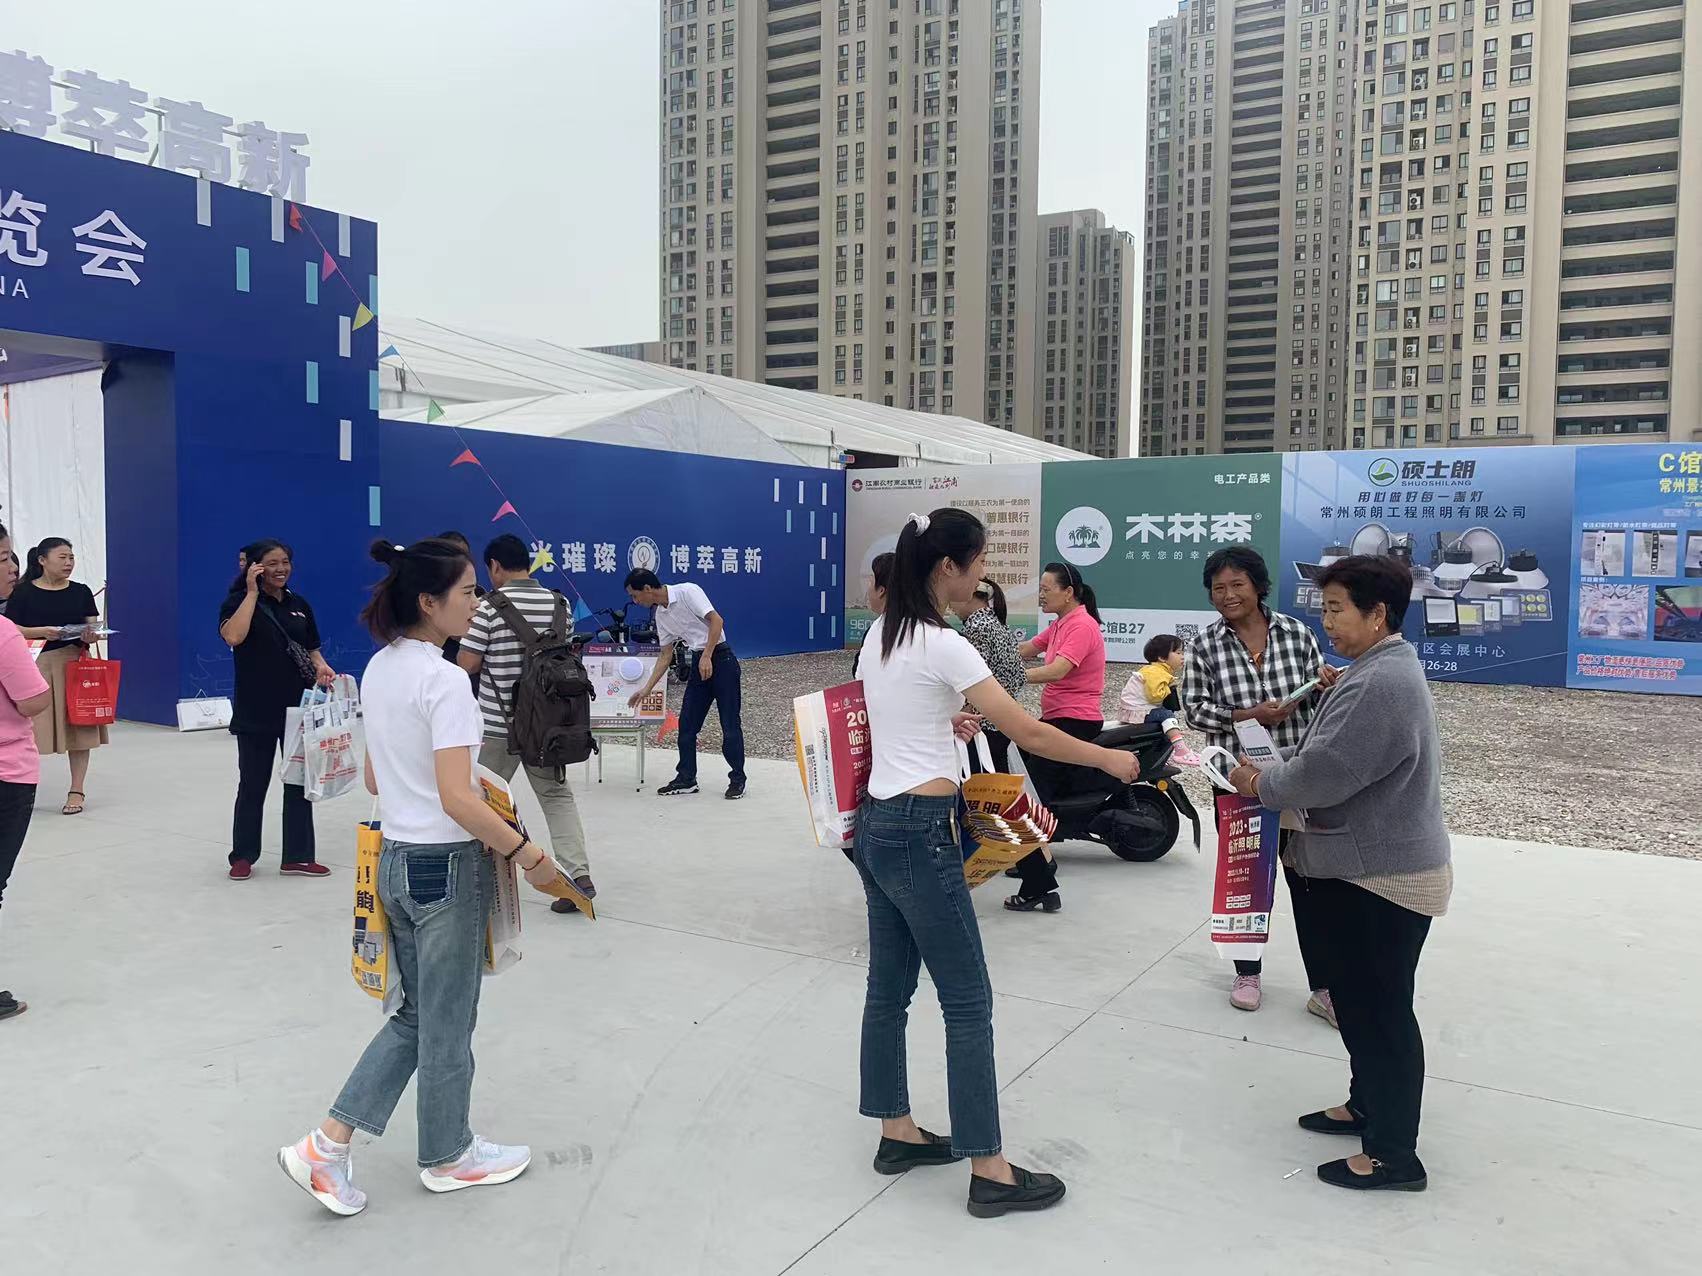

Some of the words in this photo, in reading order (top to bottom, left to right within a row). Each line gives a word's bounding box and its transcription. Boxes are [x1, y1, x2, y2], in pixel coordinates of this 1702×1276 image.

[1401, 460, 1476, 480] 硕士朗
[1214, 472, 1272, 485] 电工产品类
[1659, 477, 1702, 493] 常州景
[1358, 490, 1484, 503] 用心做好每一盏灯
[986, 511, 1030, 523] 普惠银行
[1320, 505, 1527, 519] 常州硕朗工程照明有限公司
[986, 542, 1030, 554] 口碑银行
[670, 544, 762, 574] 博萃高新
